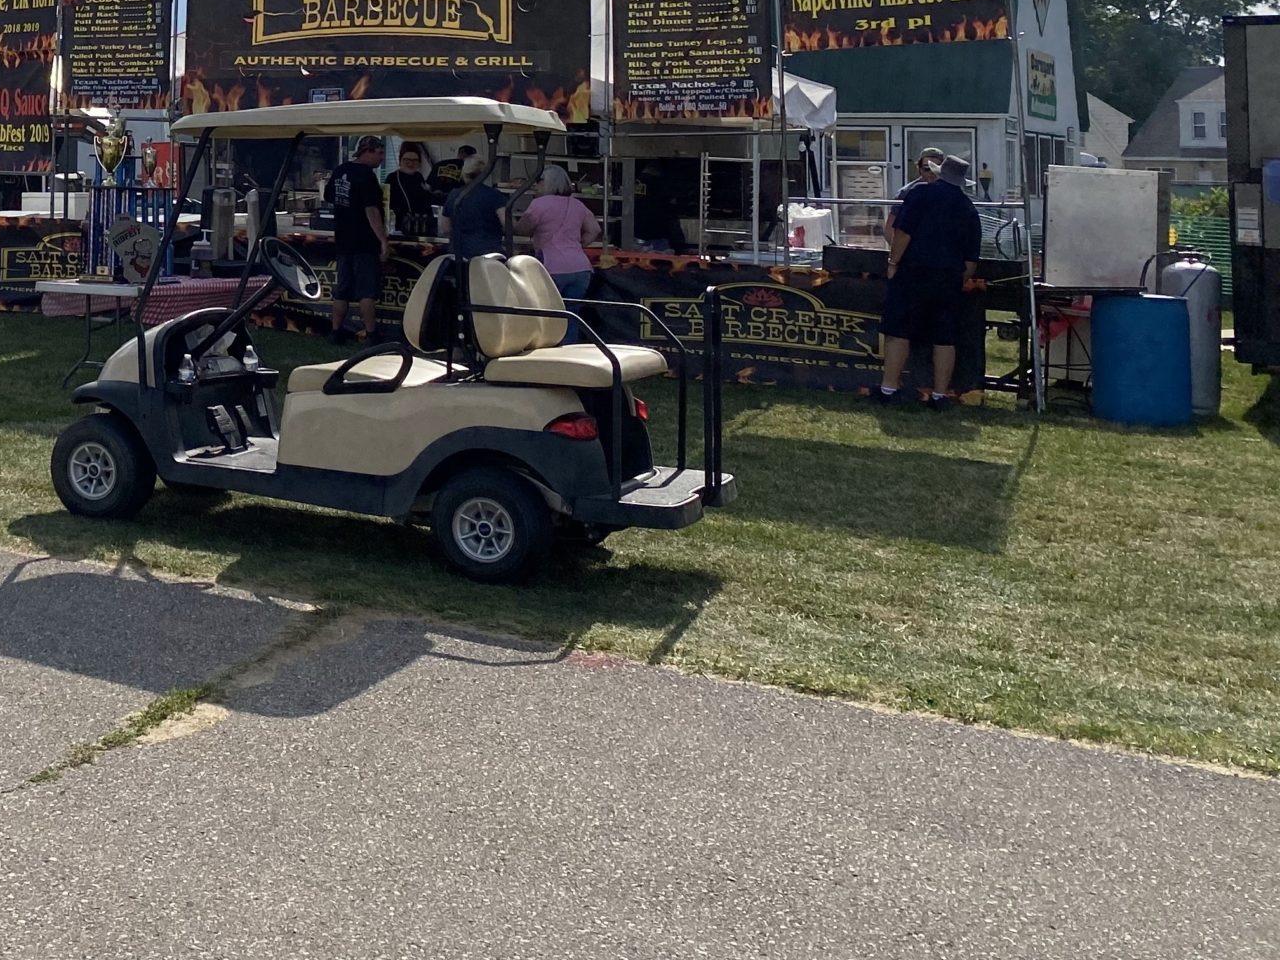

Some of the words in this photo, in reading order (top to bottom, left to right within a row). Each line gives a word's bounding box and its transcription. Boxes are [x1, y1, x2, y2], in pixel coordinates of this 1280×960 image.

[234, 55, 337, 66] AUTHENTIC
[344, 56, 449, 67] BARBECUE
[456, 56, 469, 66] &
[474, 56, 534, 67] GRILL
[14, 89, 48, 117] Sauce
[29, 124, 50, 143] 2019
[16, 251, 61, 263] SALT
